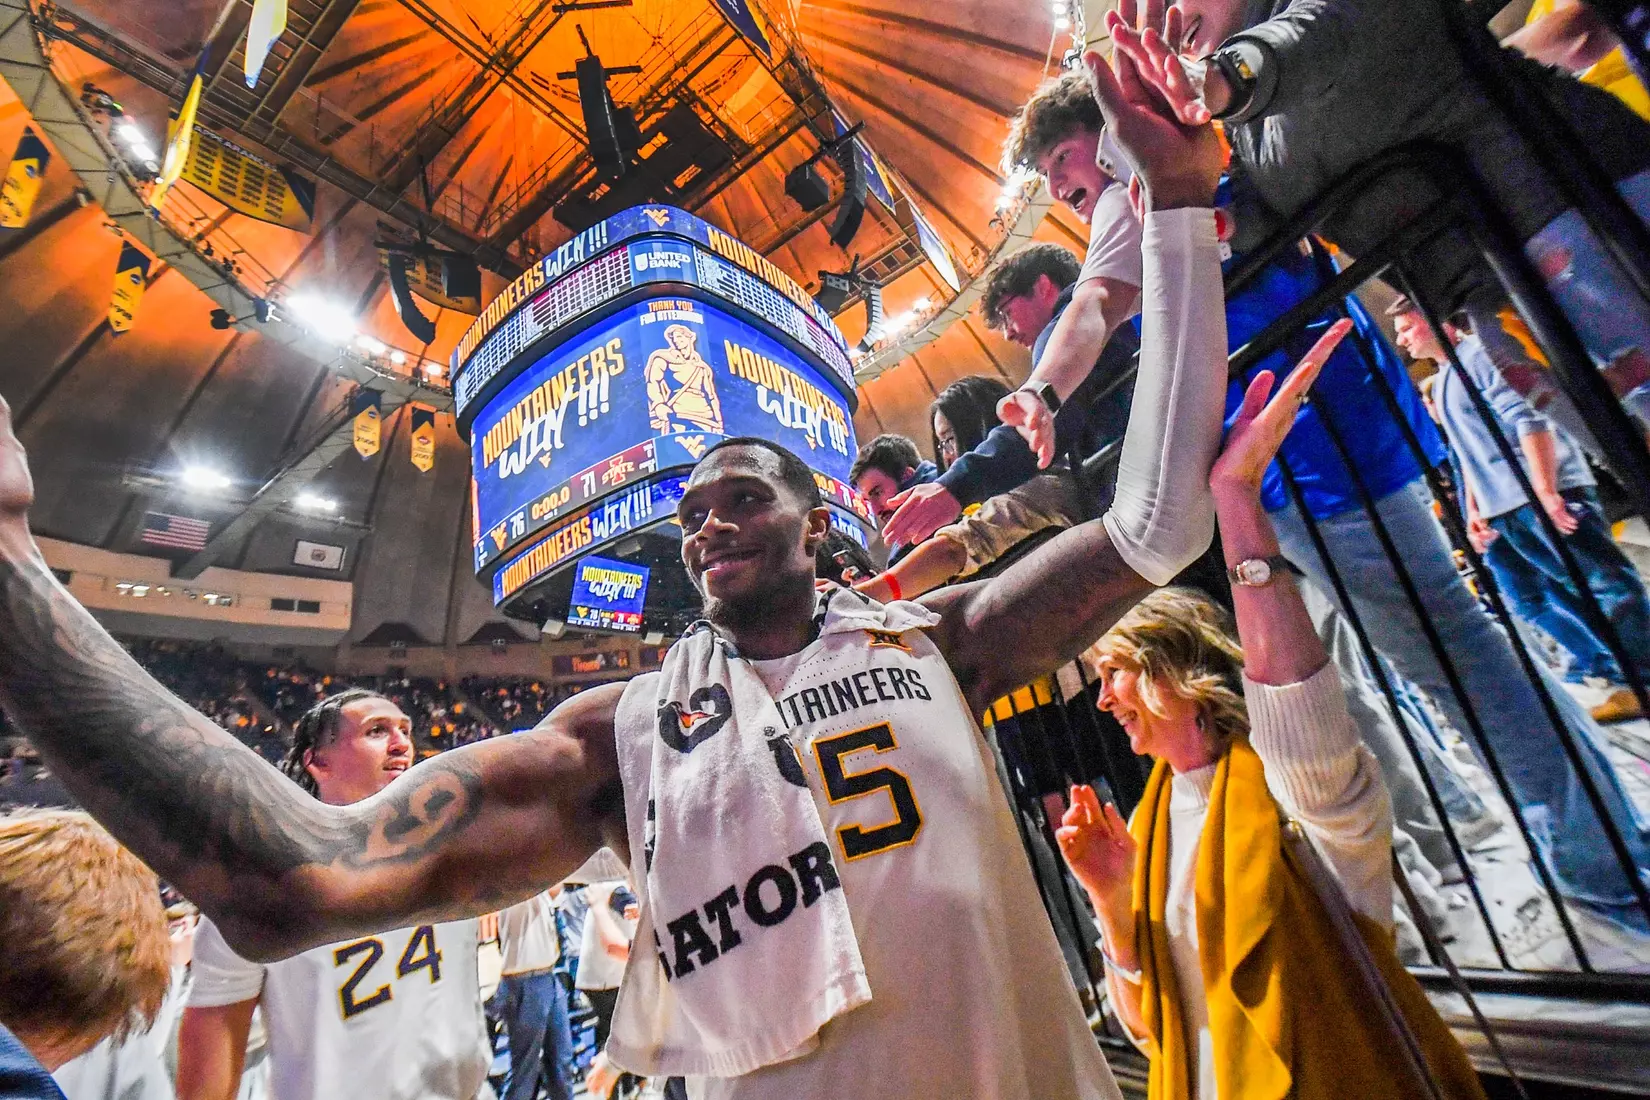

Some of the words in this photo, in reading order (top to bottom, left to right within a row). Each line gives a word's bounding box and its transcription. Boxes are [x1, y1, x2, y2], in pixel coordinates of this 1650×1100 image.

[648, 251, 691, 263] UNITED
[649, 260, 682, 269] BANK
[706, 226, 816, 317] MOUNTAINEERS
[457, 260, 545, 366] MOUNTAINEERS
[647, 300, 675, 312] THANK
[676, 300, 694, 312] YOU
[483, 338, 625, 469] MOUNTAINEERS
[724, 339, 849, 438] MOUNTAINEERS
[510, 511, 525, 539] 76
[531, 486, 571, 520] 0:00.0
[580, 470, 597, 498] 71
[502, 516, 593, 598] MOUNTAINEERS
[581, 566, 643, 589] MOUNTAINEERS
[780, 667, 932, 729] TAINEERS
[812, 720, 924, 863] 5
[654, 841, 841, 982] ATOR
[333, 925, 442, 1020] 24
